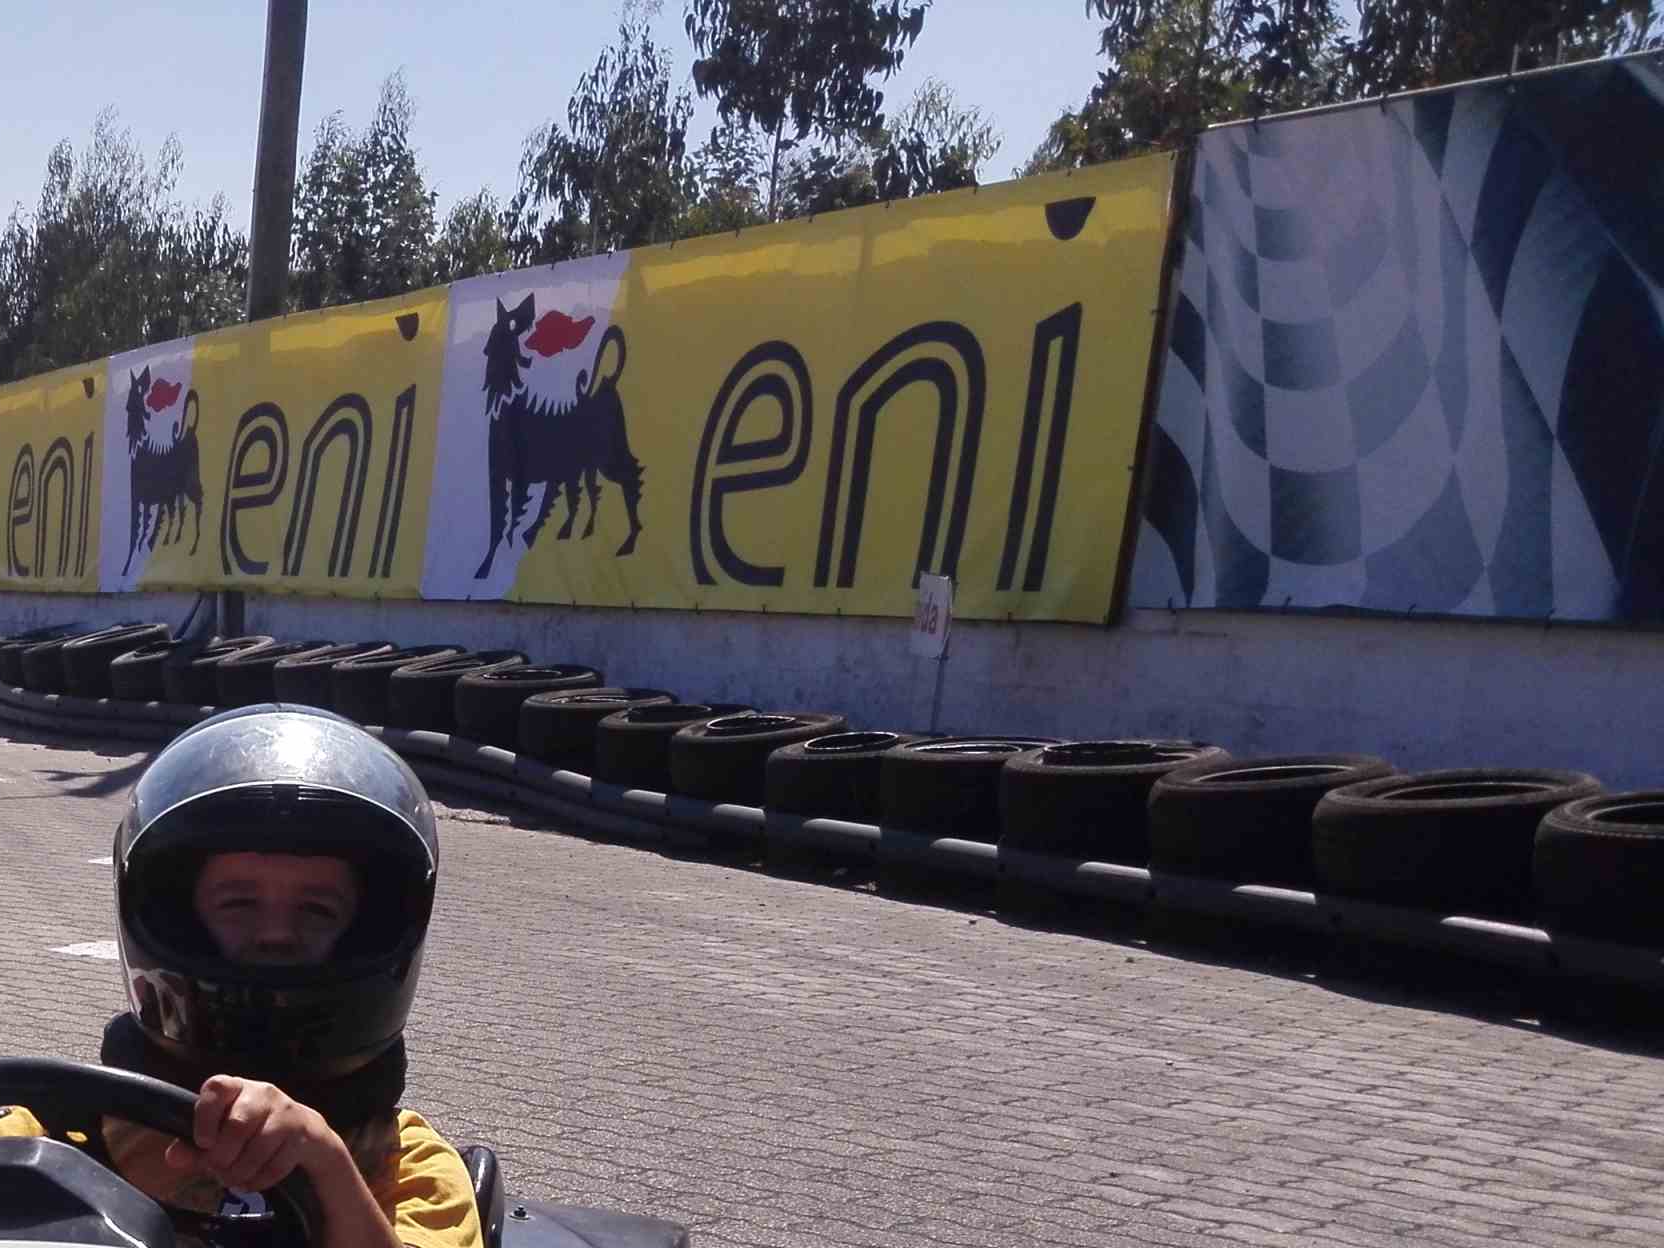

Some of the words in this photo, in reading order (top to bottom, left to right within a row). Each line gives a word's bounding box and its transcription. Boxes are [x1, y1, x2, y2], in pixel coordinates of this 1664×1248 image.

[7, 377, 95, 577] eni
[220, 305, 416, 578] eni
[689, 196, 1097, 592] eni
